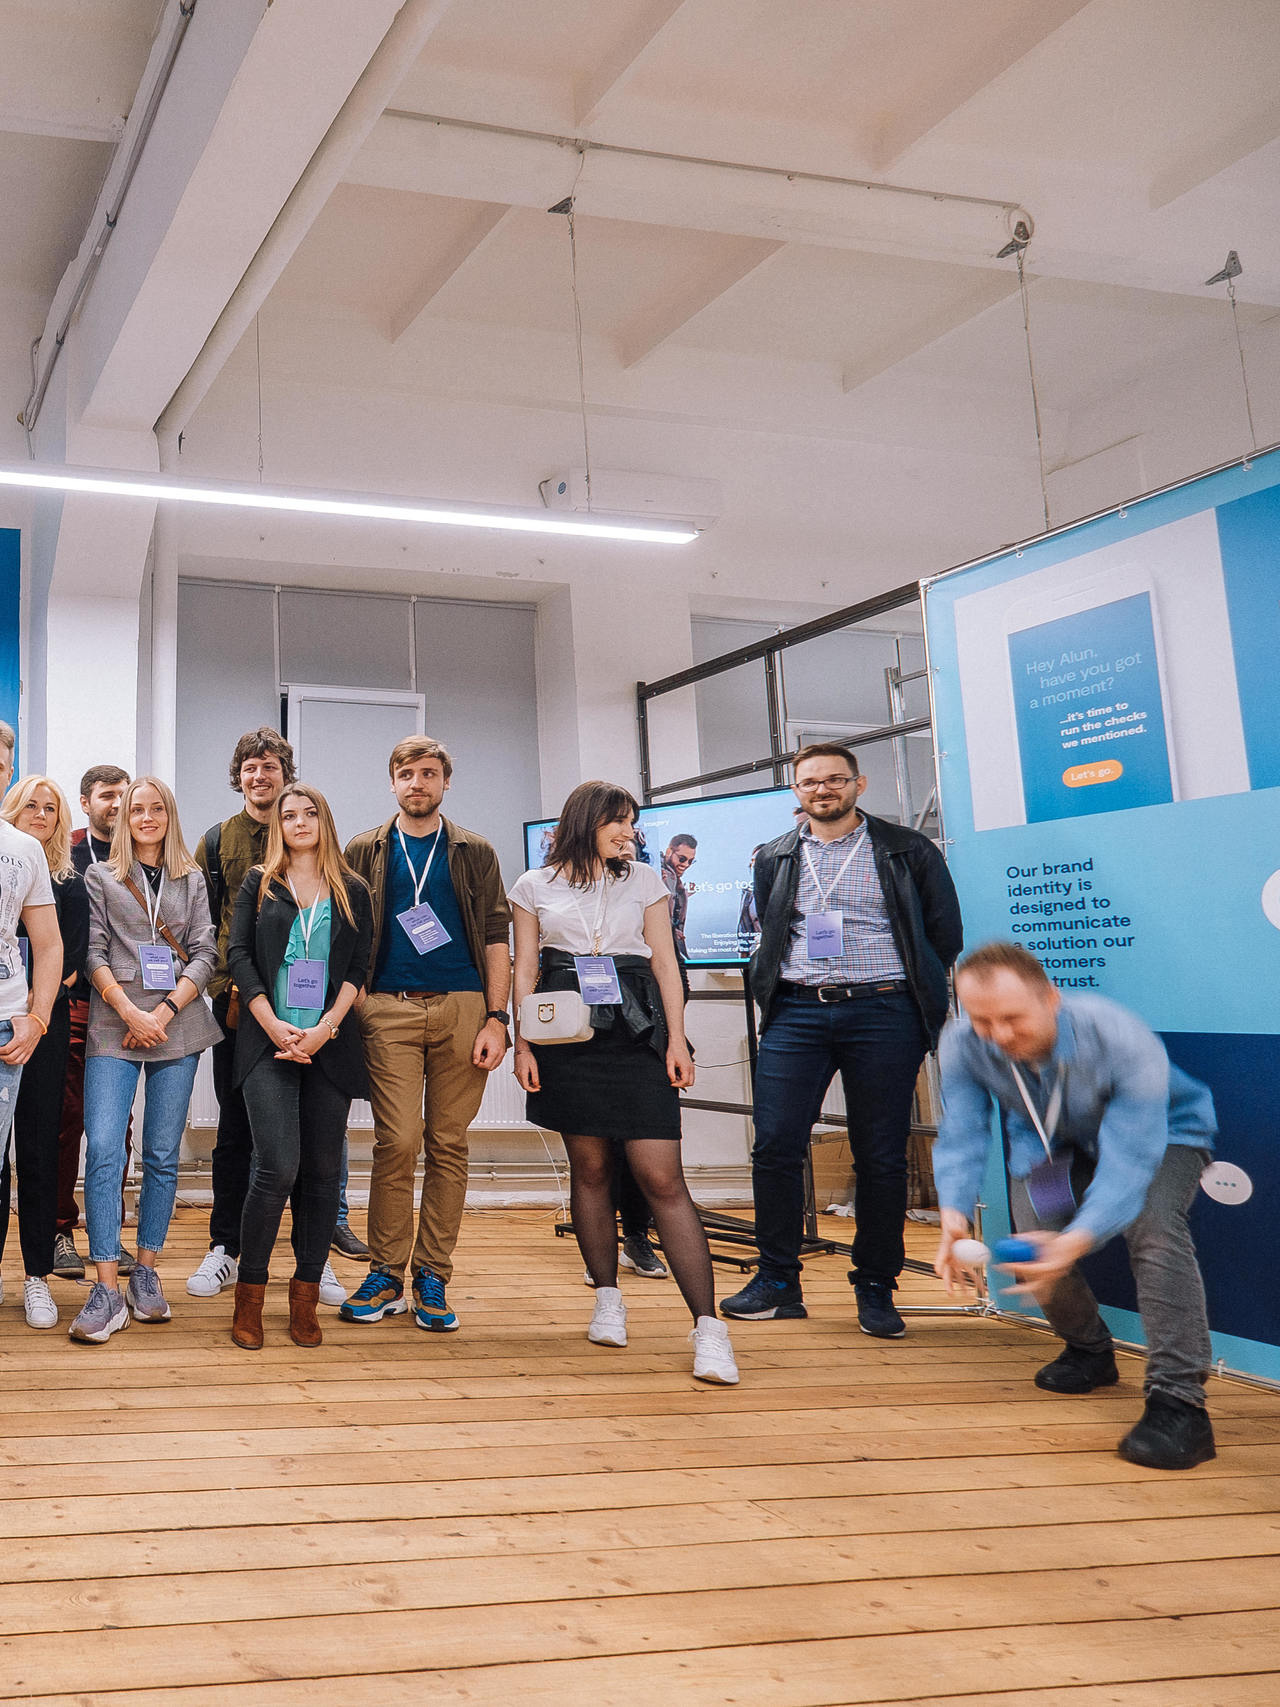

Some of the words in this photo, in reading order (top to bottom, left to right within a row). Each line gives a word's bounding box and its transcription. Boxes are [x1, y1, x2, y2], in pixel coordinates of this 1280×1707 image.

[1026, 659, 1055, 675] Hey
[1040, 671, 1076, 688] have
[1080, 662, 1110, 682] you
[1115, 652, 1142, 672] got
[1029, 699, 1039, 709] a
[1042, 677, 1114, 706] moment?
[1086, 706, 1112, 718] time
[1115, 702, 1128, 711] to
[1060, 726, 1079, 736] run
[1082, 721, 1101, 732] the
[1104, 711, 1148, 727] checks
[1062, 741, 1079, 749] we
[1081, 724, 1147, 745] mentioned.
[1006, 866, 1038, 879] Our
[1042, 858, 1094, 875] brand
[716, 882, 733, 894] go
[1008, 881, 1072, 897] identity
[1078, 878, 1093, 891] is
[1010, 897, 1086, 916] designed
[1091, 897, 1111, 909] to
[1011, 915, 1131, 933] communicate
[1028, 936, 1097, 951] solution
[1103, 936, 1135, 948] our
[1037, 957, 1106, 969] stomers
[1052, 975, 1100, 988] trust.
